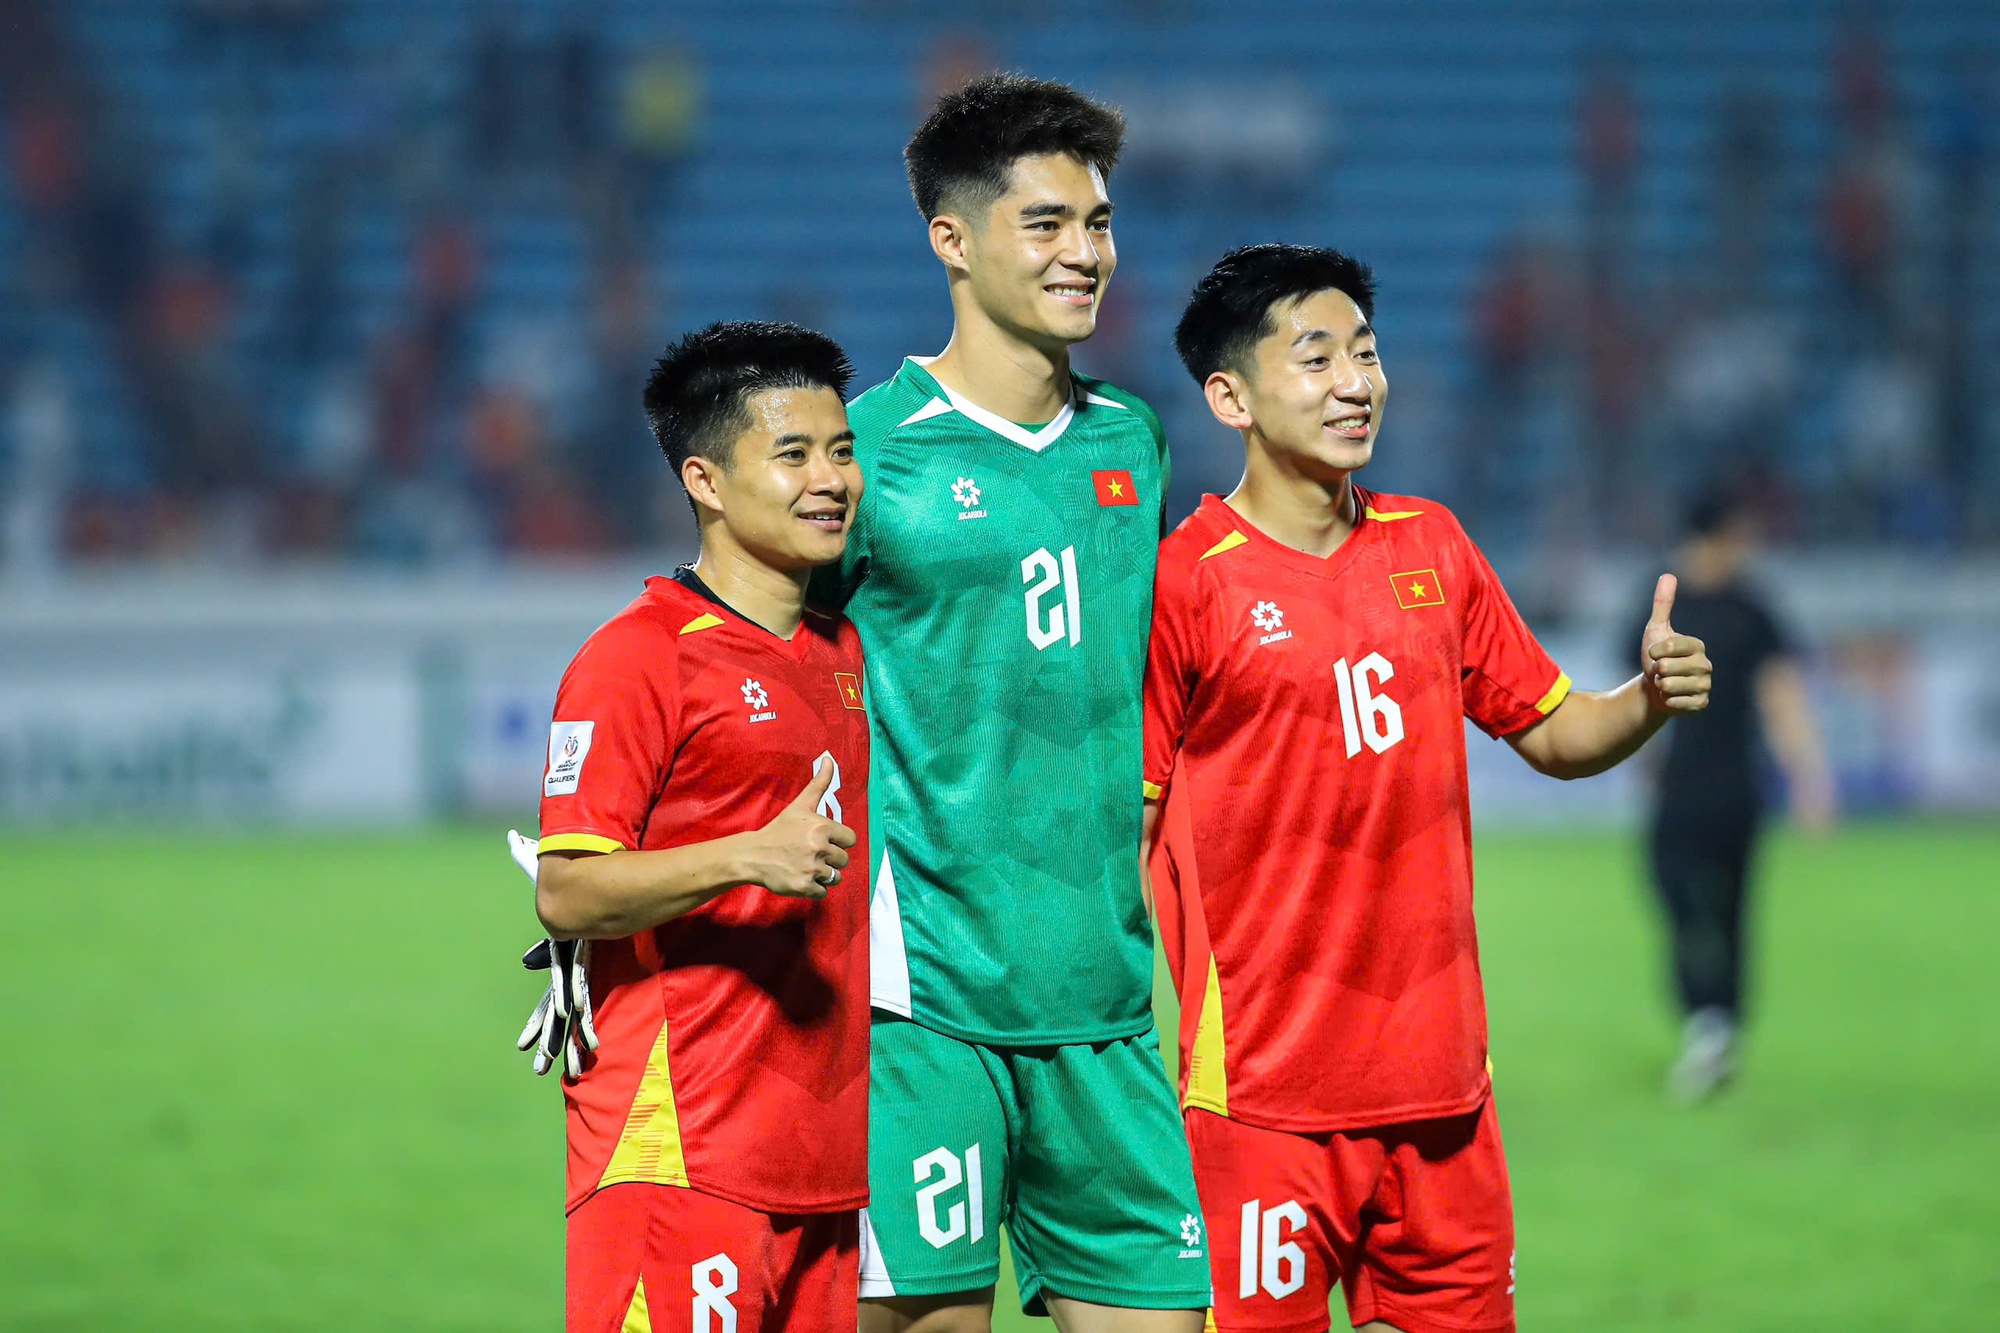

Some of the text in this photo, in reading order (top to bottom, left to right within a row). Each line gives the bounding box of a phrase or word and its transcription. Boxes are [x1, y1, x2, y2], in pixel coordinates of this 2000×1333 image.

[1020, 544, 1081, 651] 21
[1332, 650, 1406, 760] 16
[912, 1142, 984, 1250] 21
[1239, 1198, 1308, 1301] 16
[691, 1252, 739, 1333] 8
